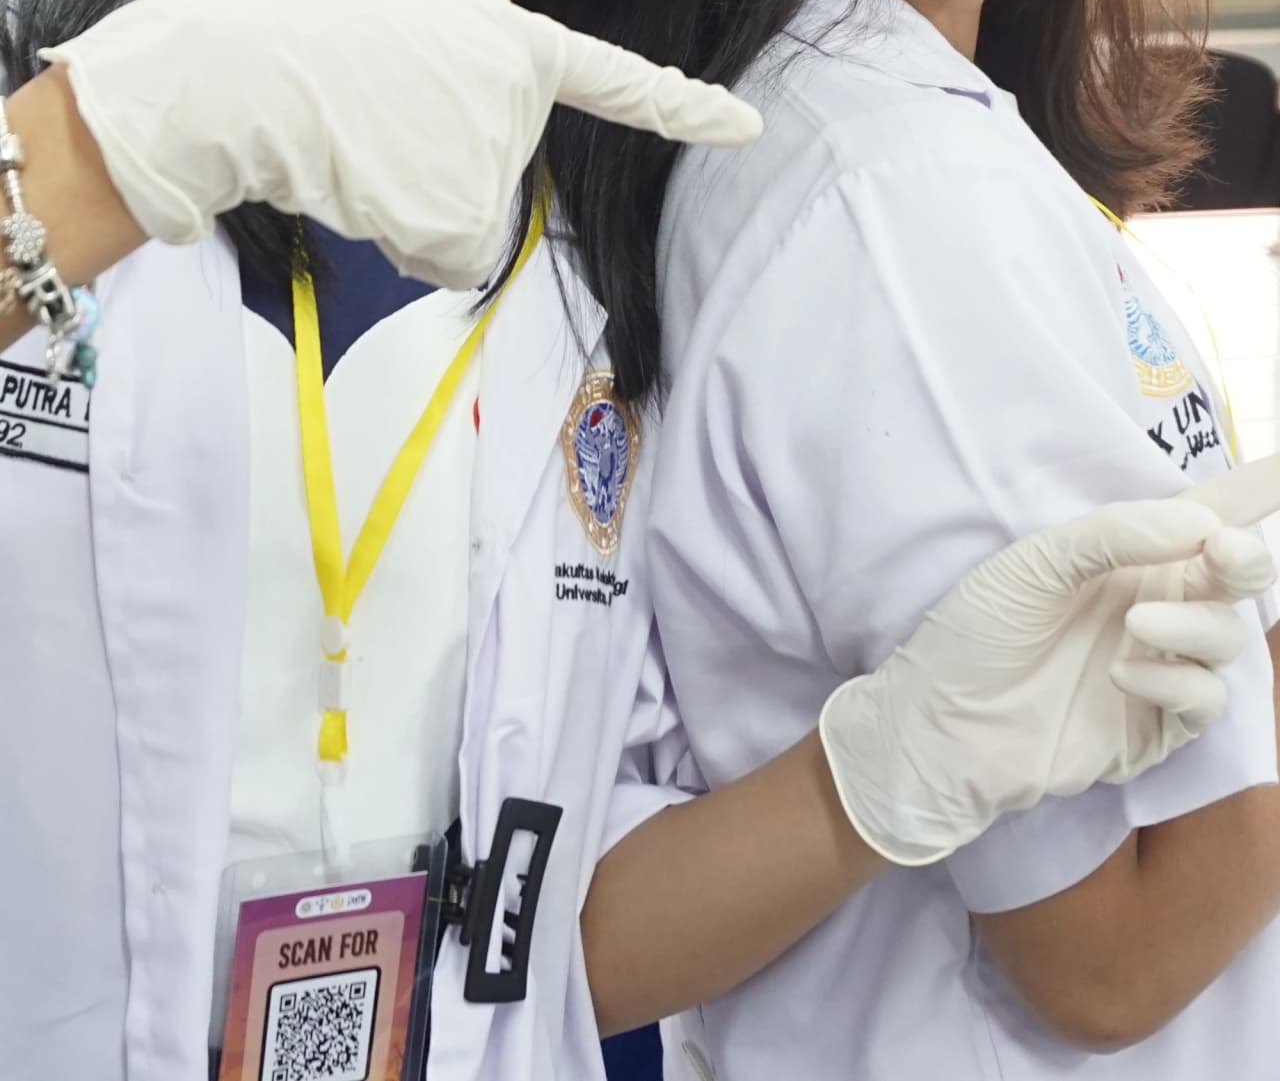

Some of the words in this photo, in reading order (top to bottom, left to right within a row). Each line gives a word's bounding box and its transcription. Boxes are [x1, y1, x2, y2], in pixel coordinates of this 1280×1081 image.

[0, 375, 71, 418] PUTRA
[278, 935, 332, 969] SCAN
[340, 930, 379, 958] FOR
